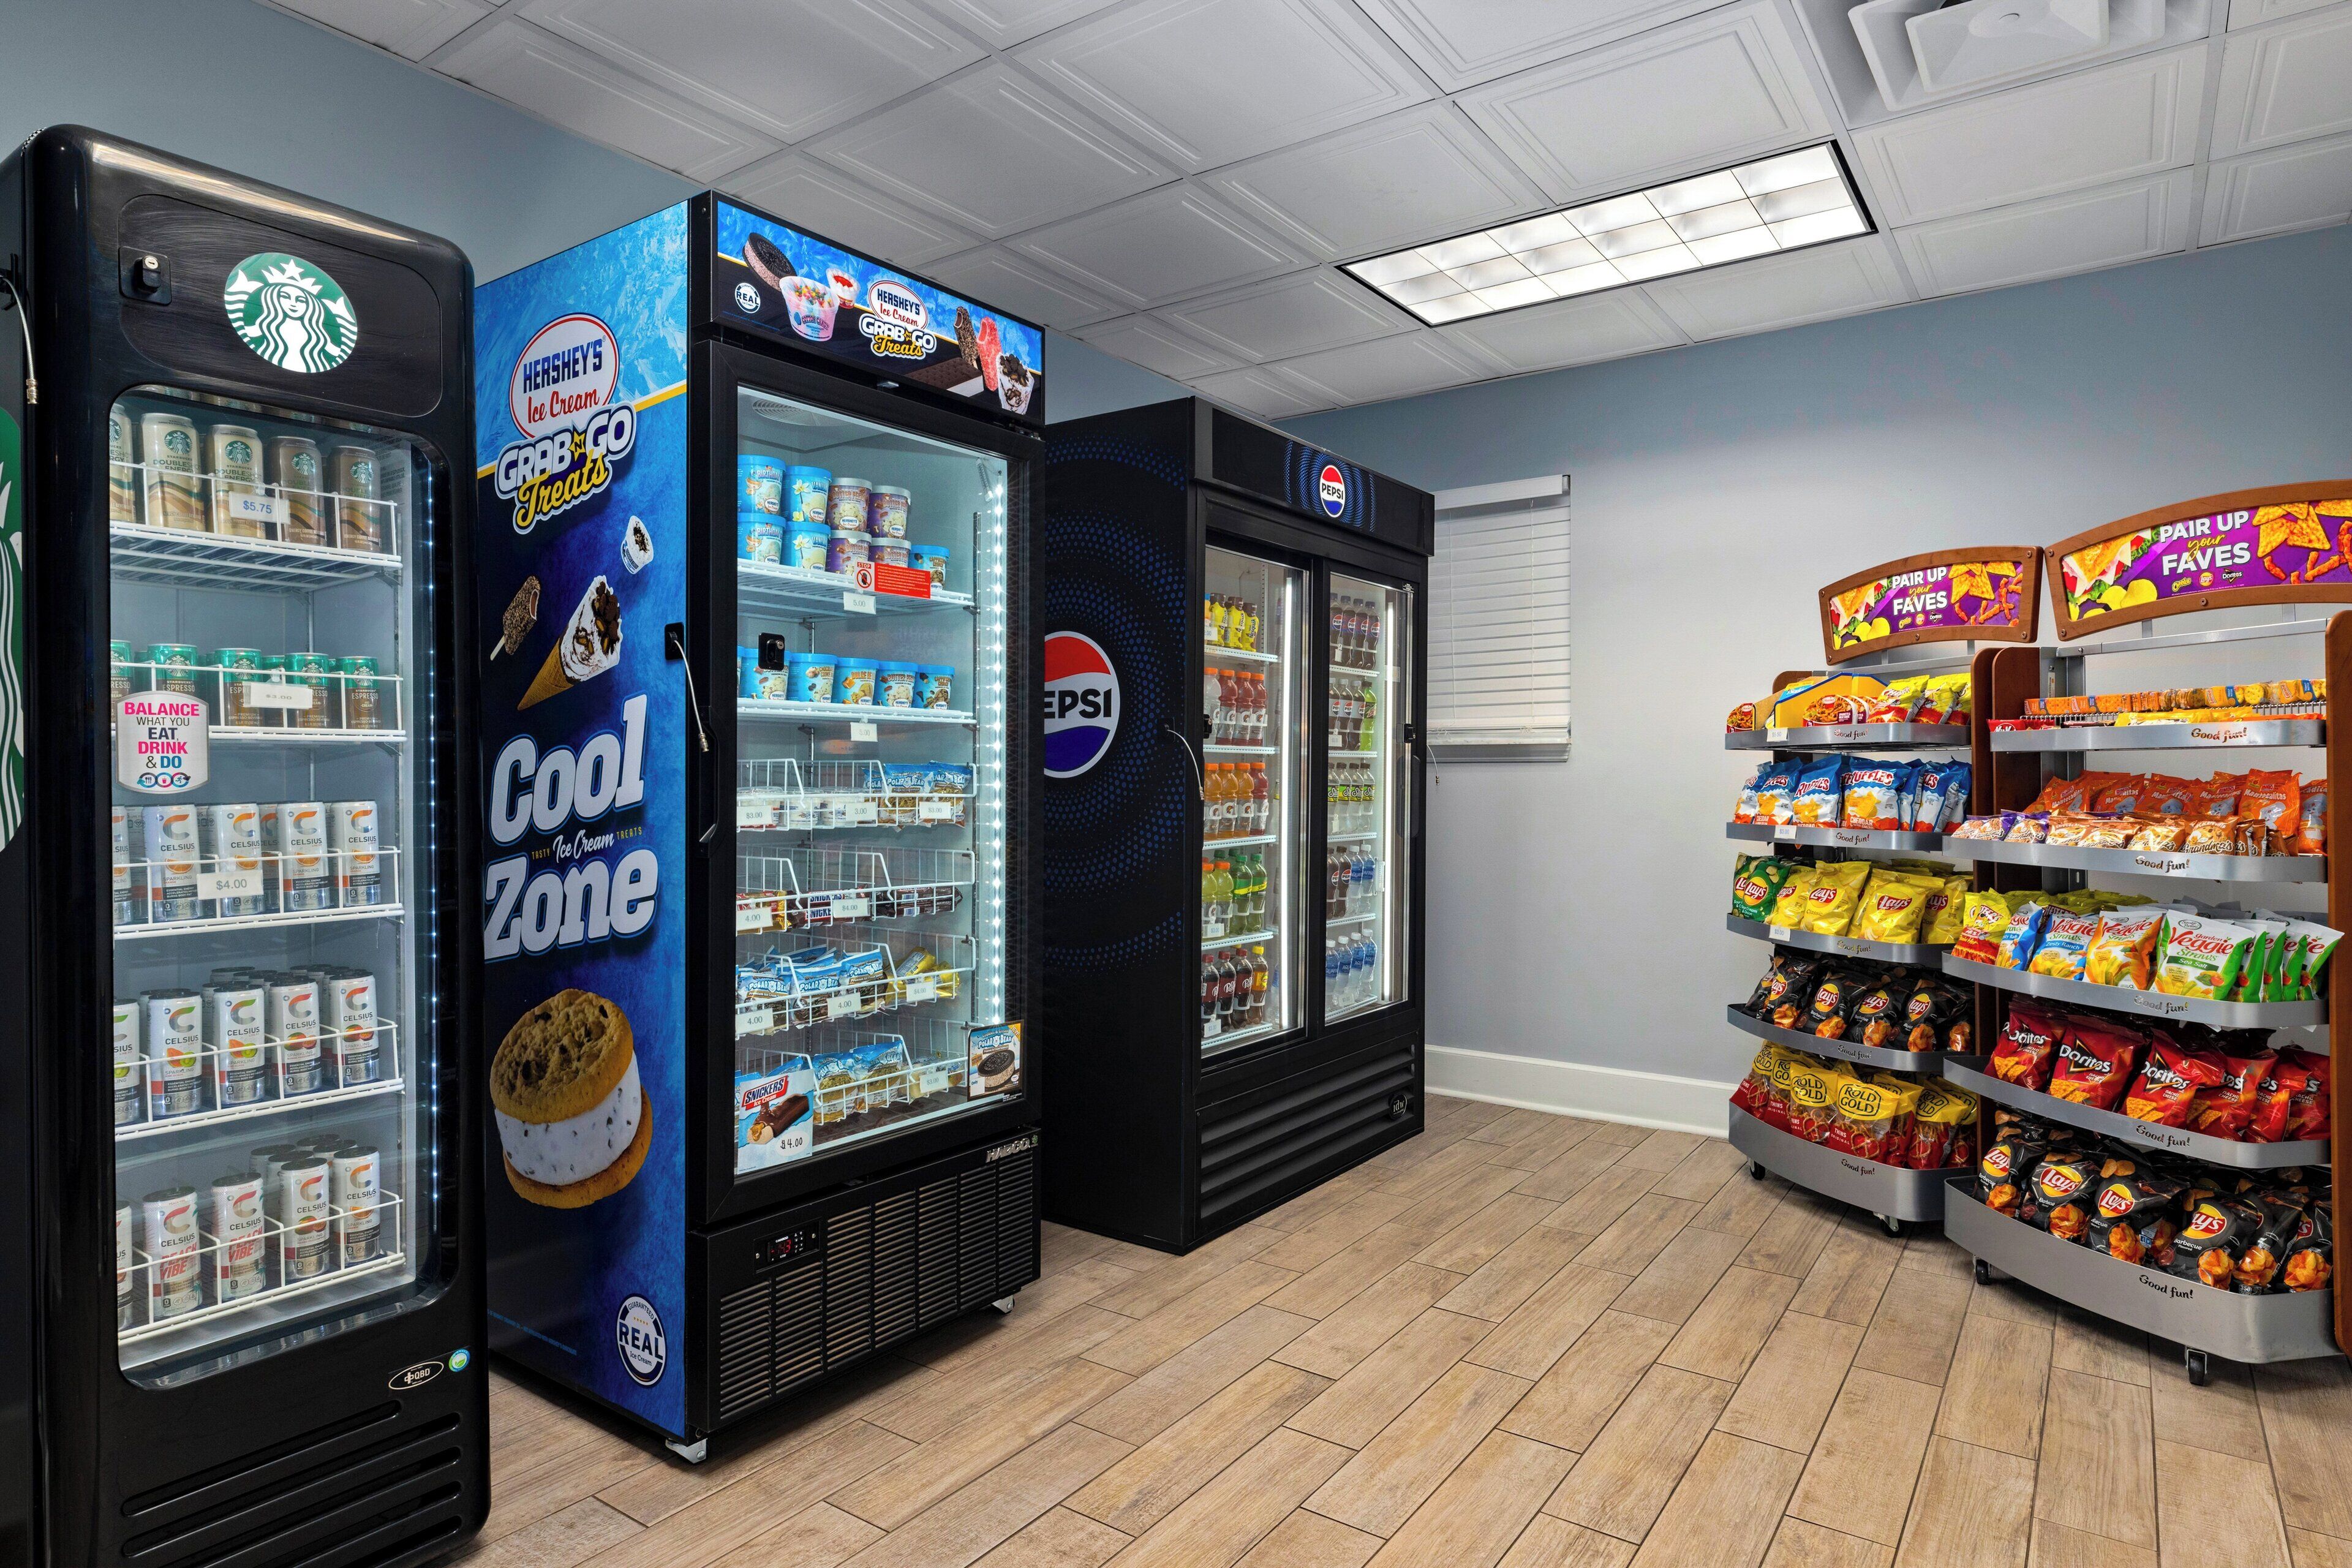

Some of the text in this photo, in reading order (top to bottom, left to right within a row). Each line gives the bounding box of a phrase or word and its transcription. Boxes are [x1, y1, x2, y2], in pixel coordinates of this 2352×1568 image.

[736, 291, 760, 305] REAL
[877, 288, 920, 316] HERSHEY'S
[880, 303, 919, 327] Ice Cream
[862, 317, 905, 342] GRAB
[911, 330, 934, 350] GO
[873, 335, 923, 356] Treats
[523, 337, 603, 394] HERSHEY'S
[527, 387, 600, 424] Ice Cream
[497, 429, 573, 492] GRAB
[585, 405, 633, 459] GO
[516, 448, 609, 527] Treats
[1321, 483, 1344, 500] PEPSI
[243, 500, 272, 514] $5.75
[2160, 510, 2249, 543] PAIR UP
[2187, 534, 2226, 563] your
[2162, 542, 2251, 576] FAVES
[1892, 567, 1947, 589] PAIR UP
[2172, 571, 2242, 592] Cheetos Doritos
[1909, 584, 1932, 606] your
[1893, 591, 1948, 616] FAVES
[2280, 683, 2292, 699] Lance
[124, 702, 200, 716] BALANCE
[1044, 687, 1112, 719] EPSI
[137, 717, 190, 726] WHAT YOU
[148, 728, 179, 741] EAT,
[1834, 728, 1869, 741] Good fun!
[2191, 726, 2247, 743] Good fun!
[138, 741, 188, 754] DRINK
[146, 755, 182, 769] & DO
[490, 693, 647, 843] Cool
[1795, 777, 1830, 797] RUFFLES
[2218, 785, 2235, 794] BIMBO
[1850, 816, 1873, 826] CHEDDAR
[231, 840, 260, 848] CELSIUS
[532, 826, 643, 863] TASTY Ice Cream TREATS
[1836, 832, 1870, 845] Good fun!
[160, 843, 195, 852] CELSIUS
[2184, 840, 2233, 854] Grandma's
[2135, 856, 2190, 873] Good fun!
[216, 879, 247, 891] $4.00
[1746, 882, 1767, 899] Lay's
[1809, 888, 1837, 903] Lay's
[1878, 895, 1912, 910] Lay's
[484, 848, 658, 960] Zone
[2049, 919, 2096, 937] Veggie
[2102, 921, 2152, 937] Veggie
[2049, 932, 2082, 941] Straws
[2168, 926, 2234, 955] Veggie
[2193, 932, 2223, 942] garden
[1838, 940, 1871, 954] Good fun!
[2176, 948, 2218, 962] Straws
[2193, 960, 2208, 968] Salt
[749, 981, 768, 991] POLAR
[800, 981, 819, 992] POLAR
[1816, 987, 1838, 1006] Lay's
[1909, 998, 1929, 1014] Lay's
[2134, 994, 2188, 1015] Good fun!
[343, 1012, 373, 1022] CELSIUS
[747, 1016, 763, 1025] 4.00
[1811, 1010, 1826, 1020] Barbecue
[227, 1027, 260, 1036] CELSIUS
[285, 1020, 316, 1030] CELSIUS
[165, 1035, 199, 1045] CELSIUS
[978, 1035, 1012, 1049] POLAR BEAR
[1756, 1055, 1772, 1068] GOLD
[2059, 1044, 2111, 1072] Doritos
[1793, 1077, 1823, 1089] ROLD
[2141, 1061, 2191, 1090] Doritos
[745, 1078, 784, 1103] SNICKERS
[1844, 1086, 1877, 1102] ROLD
[1921, 1090, 1945, 1106] ROLD
[2163, 1093, 2177, 1101] CHEESE
[2218, 1093, 2239, 1102] CHEESE
[2222, 1090, 2239, 1099] NACHO
[762, 1094, 777, 1103] Cream
[1841, 1096, 1874, 1113] GOLD
[1831, 1134, 1850, 1145] ORIGINAL
[1834, 1128, 1847, 1138] THINS
[2136, 1125, 2191, 1147] Good fun!
[1841, 1158, 1875, 1176] Good fun!
[1978, 1172, 1996, 1186] Barbecue
[2042, 1169, 2080, 1191] Lay's
[347, 1188, 377, 1200] CELSIUS
[2100, 1189, 2132, 1211] Lay's
[297, 1201, 327, 1214] CELSIUS
[230, 1217, 261, 1231] CELSIUS
[161, 1232, 195, 1247] CELSIUS
[2174, 1238, 2202, 1250] Barbecue
[228, 1246, 254, 1263] VIBE
[160, 1263, 188, 1280] VIBE
[2139, 1275, 2193, 1299] Good fun!
[628, 1301, 654, 1320] GUARANTEED
[619, 1322, 663, 1360] REAL
[637, 1354, 652, 1366] Cream
